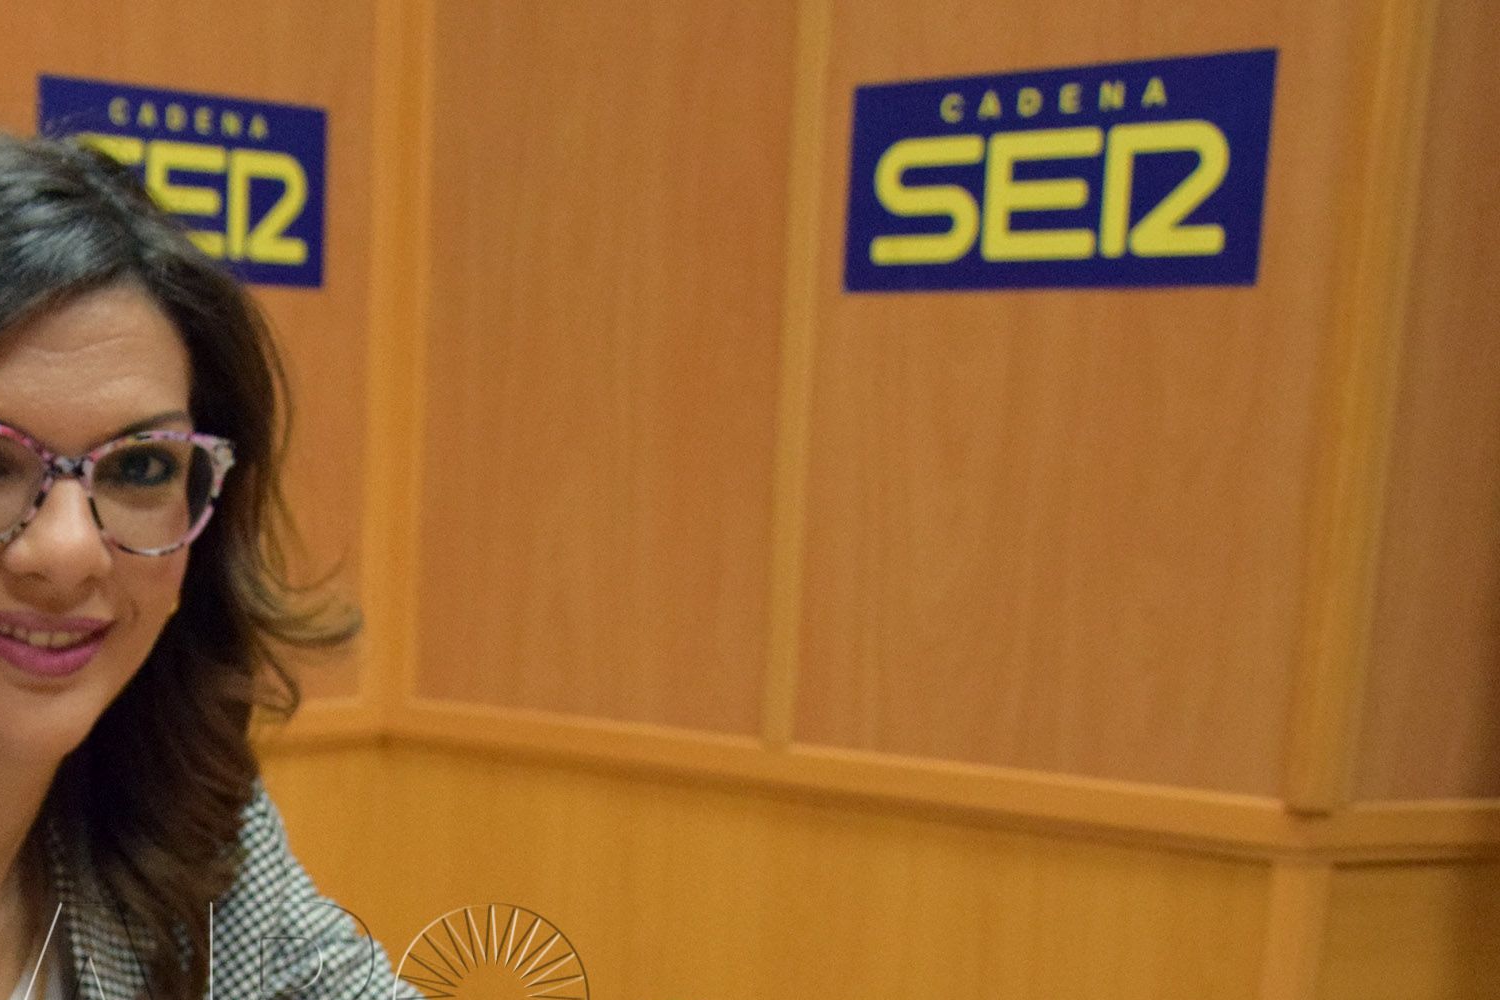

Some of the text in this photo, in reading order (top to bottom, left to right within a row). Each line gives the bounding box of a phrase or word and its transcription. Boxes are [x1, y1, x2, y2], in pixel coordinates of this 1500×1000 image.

[108, 97, 269, 140] CADENA
[939, 77, 1167, 123] CADENA
[75, 133, 308, 265] ER
[870, 119, 1230, 266] SER
